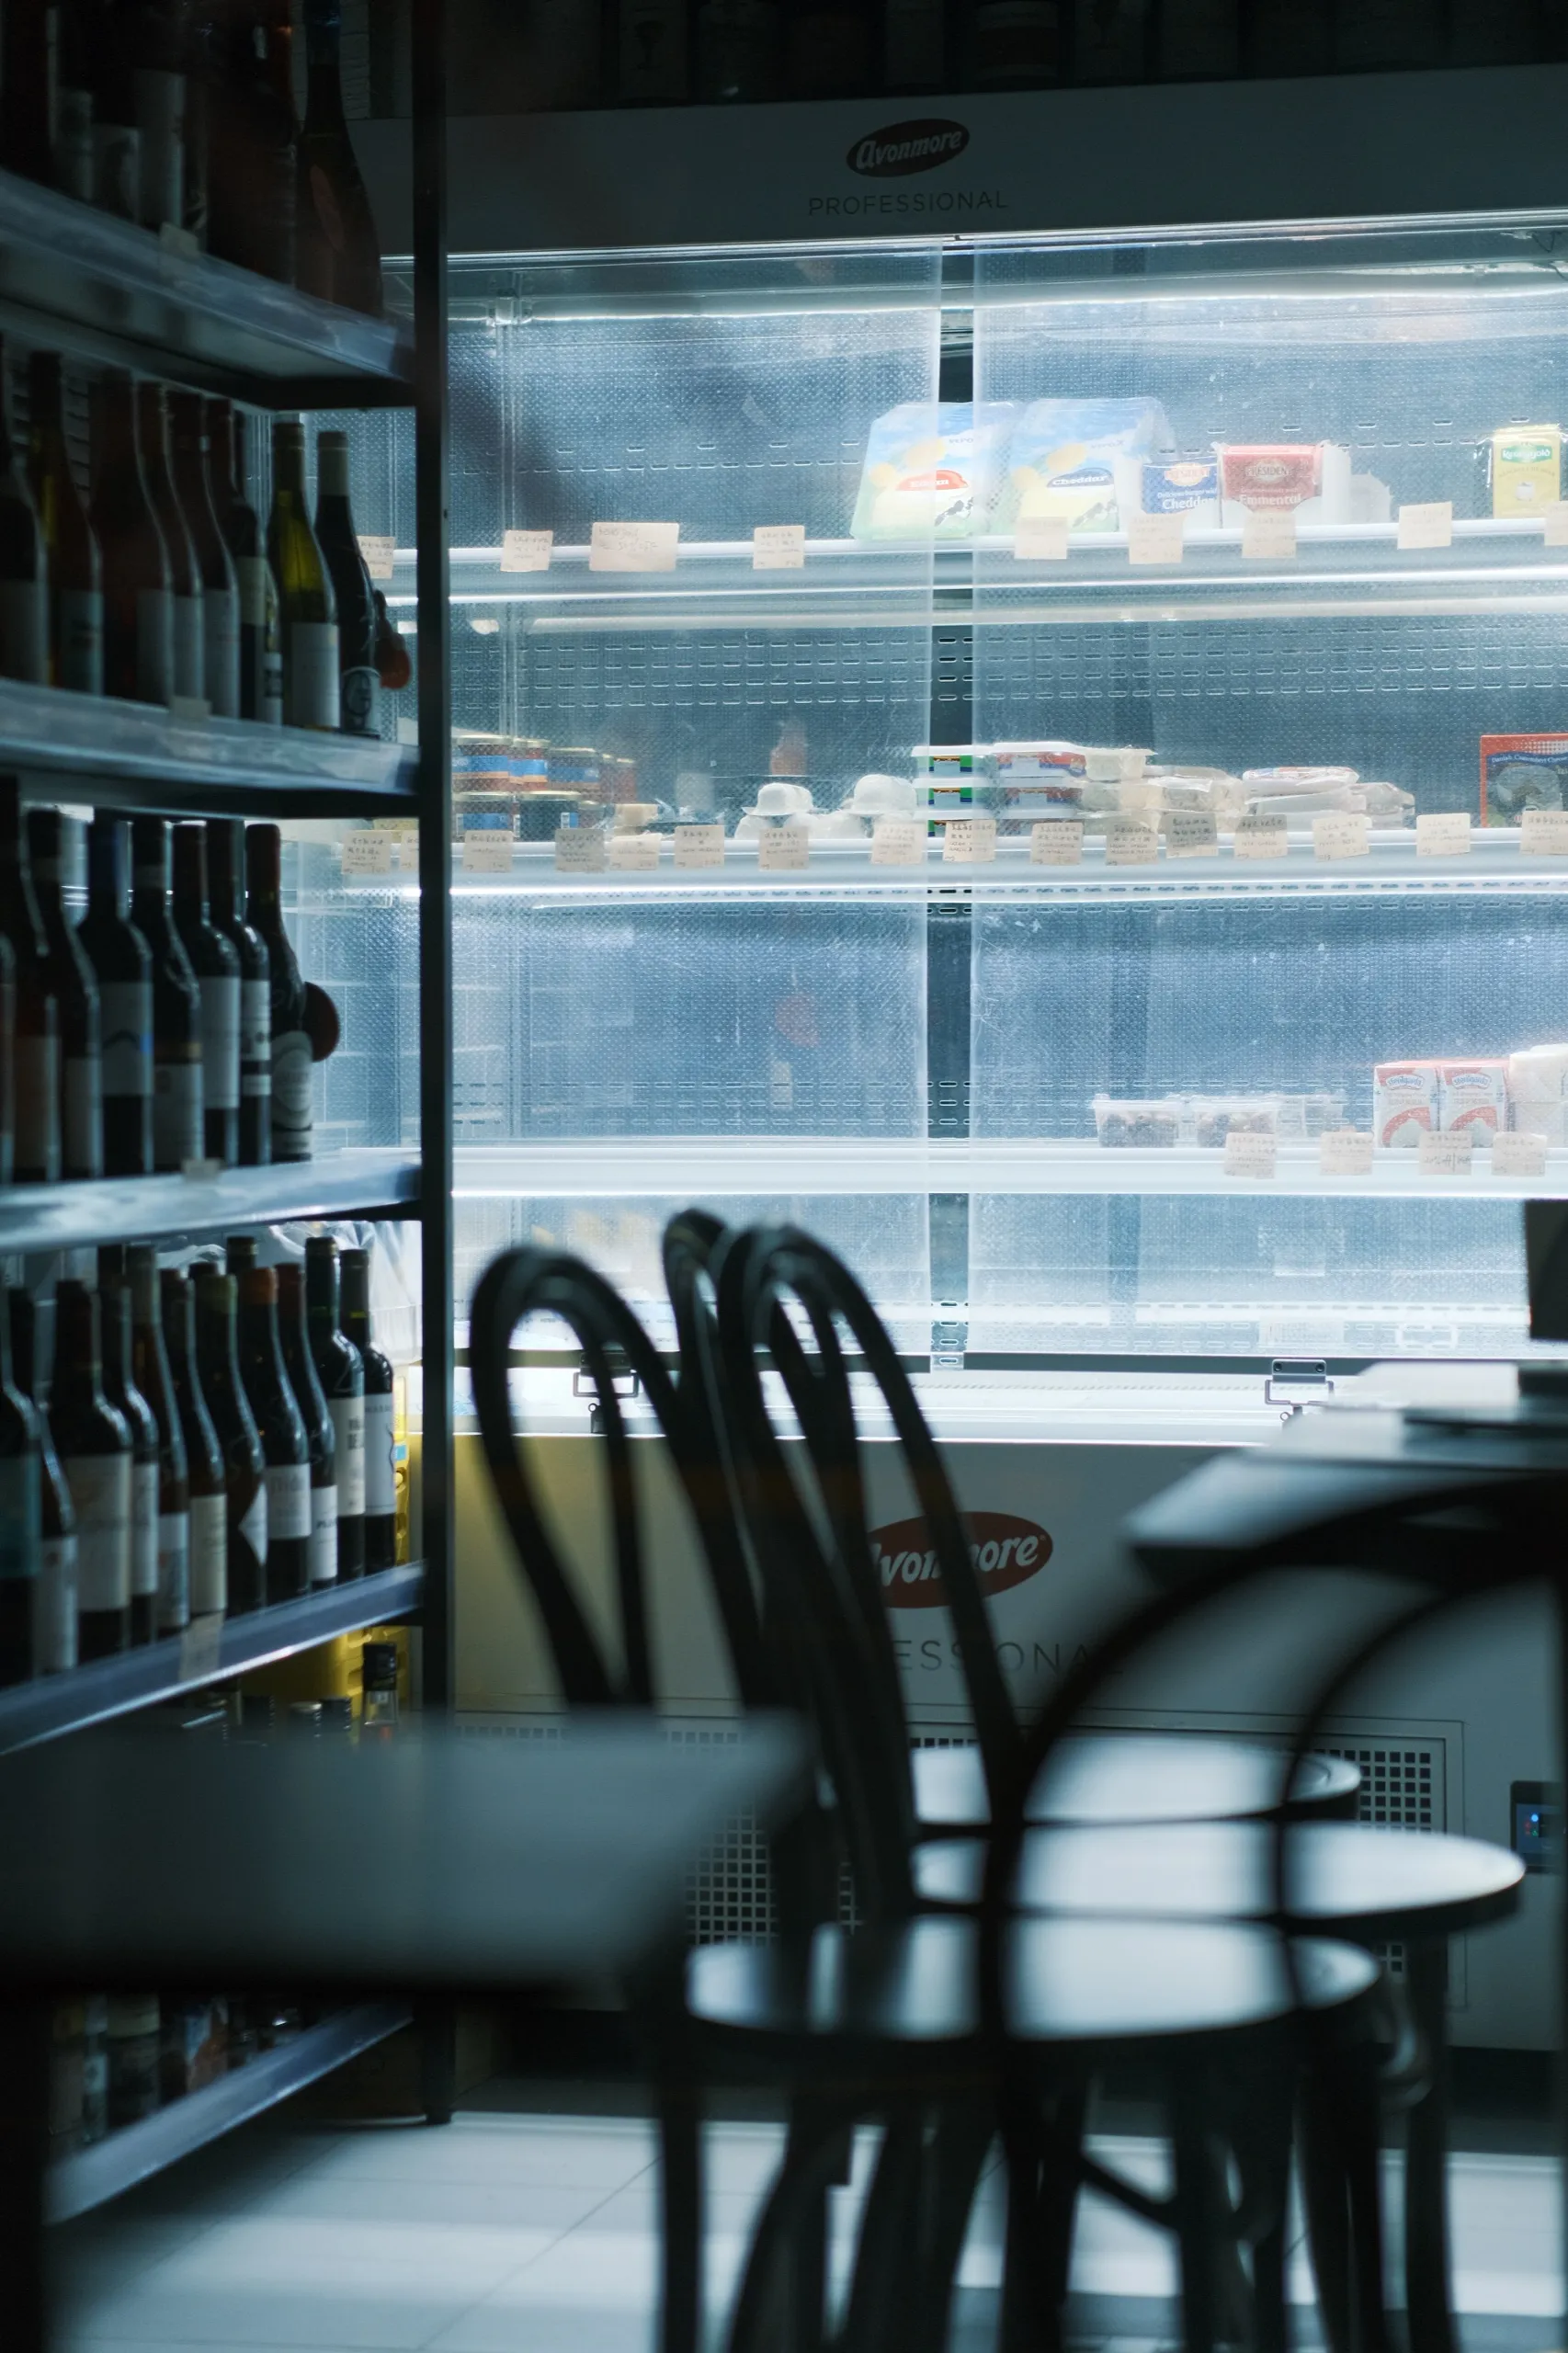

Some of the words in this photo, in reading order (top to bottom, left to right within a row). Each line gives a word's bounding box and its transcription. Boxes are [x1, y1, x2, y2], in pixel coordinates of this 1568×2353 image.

[808, 189, 1009, 217] PROFESSIONAL
[1051, 474, 1108, 486] Cheddar
[1162, 496, 1214, 510] Cheddar
[1239, 493, 1302, 506] Emmental
[871, 1534, 1039, 1587] vonore
